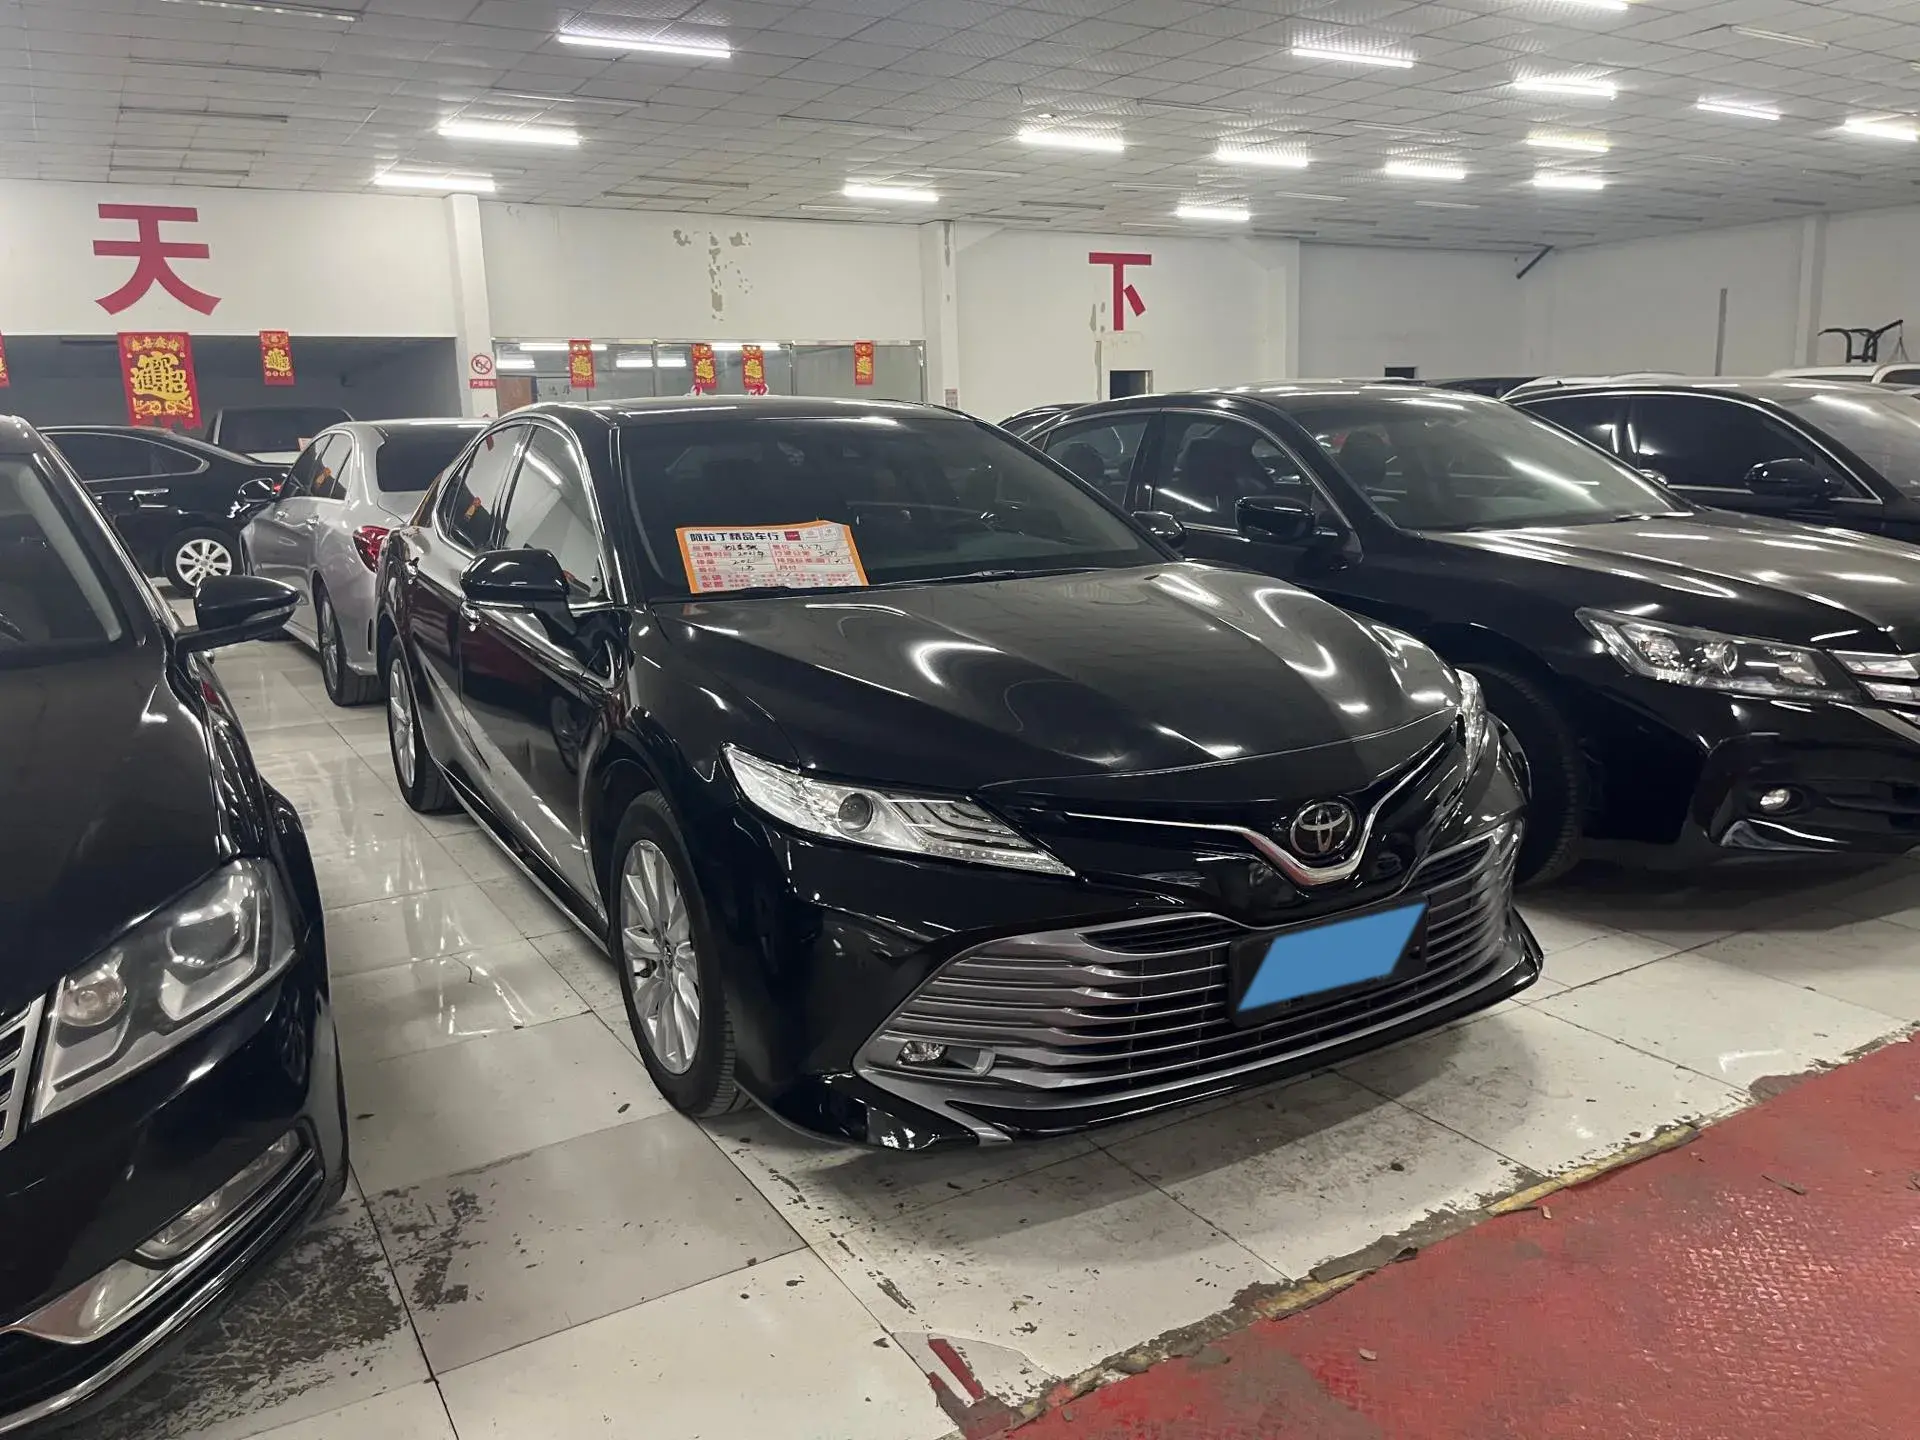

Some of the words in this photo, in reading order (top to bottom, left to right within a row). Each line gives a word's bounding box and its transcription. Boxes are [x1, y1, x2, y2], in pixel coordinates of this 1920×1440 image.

[92, 203, 222, 316] 天
[1088, 252, 1153, 331] 下
[689, 532, 780, 542] 阿拉丁精品车行
